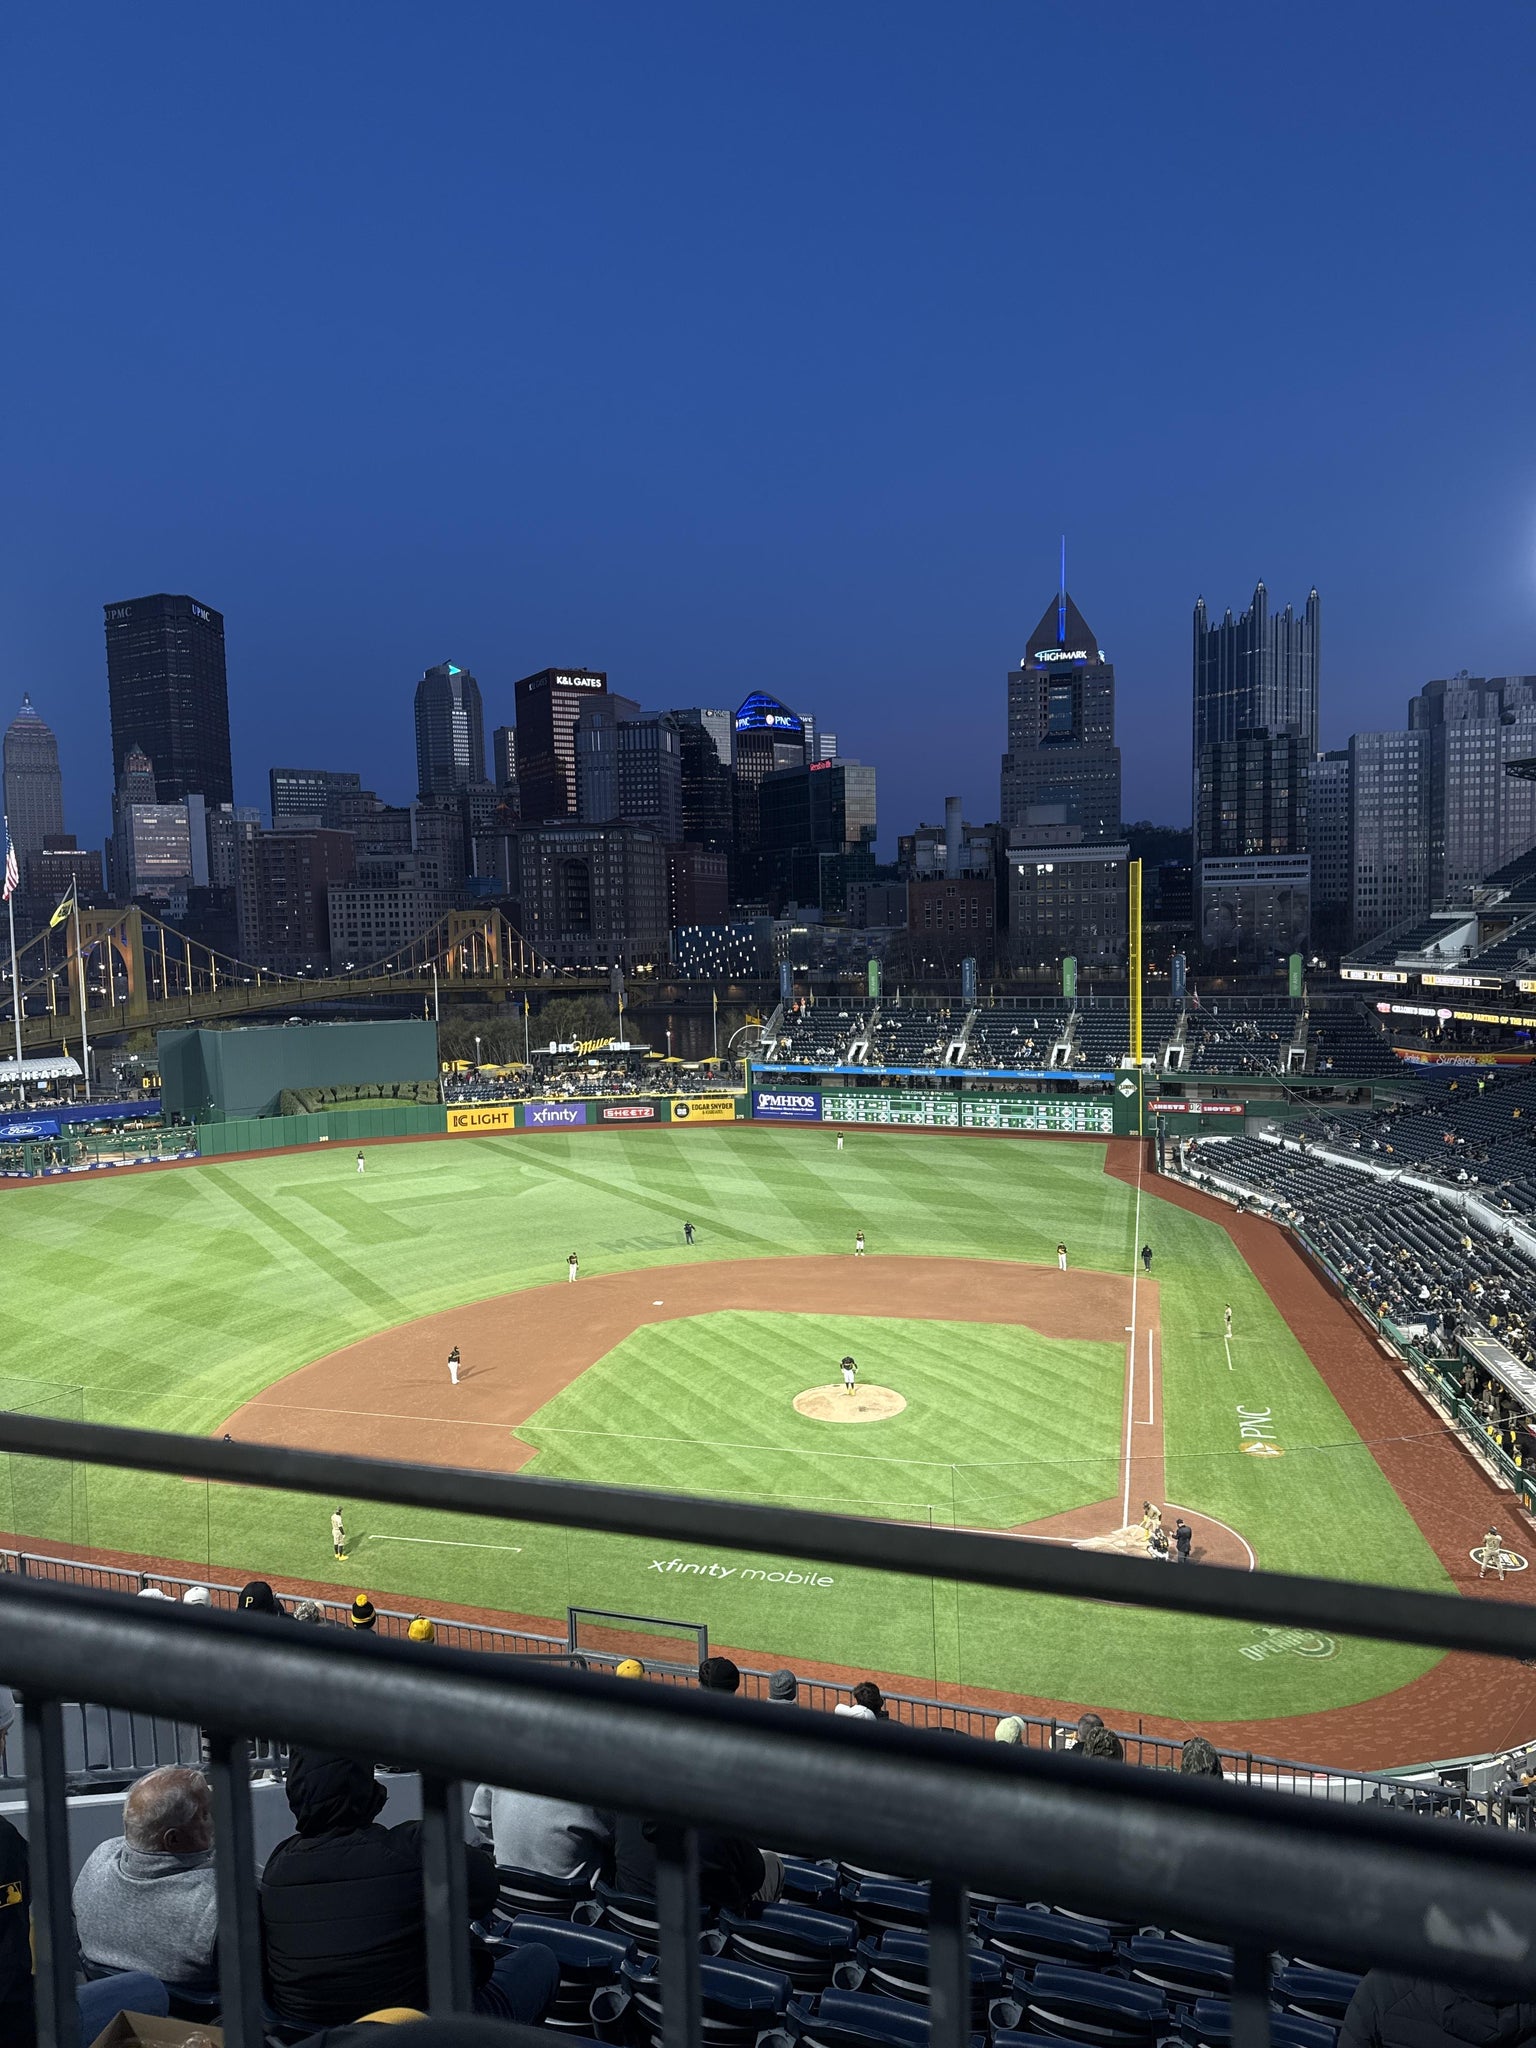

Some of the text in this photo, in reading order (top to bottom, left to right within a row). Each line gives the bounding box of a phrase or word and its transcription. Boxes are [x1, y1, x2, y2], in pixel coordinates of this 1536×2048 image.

[105, 606, 133, 621] UPMC
[191, 604, 210, 622] UPMC
[1036, 649, 1087, 662] HIGHMARK
[556, 676, 602, 688] K&L GATES
[738, 717, 750, 728] PNC
[775, 715, 792, 727] PNC
[572, 1037, 616, 1057] Miller
[21, 1067, 73, 1081] HEAD'S
[471, 1113, 509, 1126] LIGHT
[533, 1109, 578, 1124] xfinity
[606, 1108, 651, 1118] SHEETZ
[8, 1126, 36, 1135] Ford
[1236, 1405, 1277, 1439] PNC
[647, 1558, 834, 1587] xfinity mobile
[245, 1597, 253, 1607] P
